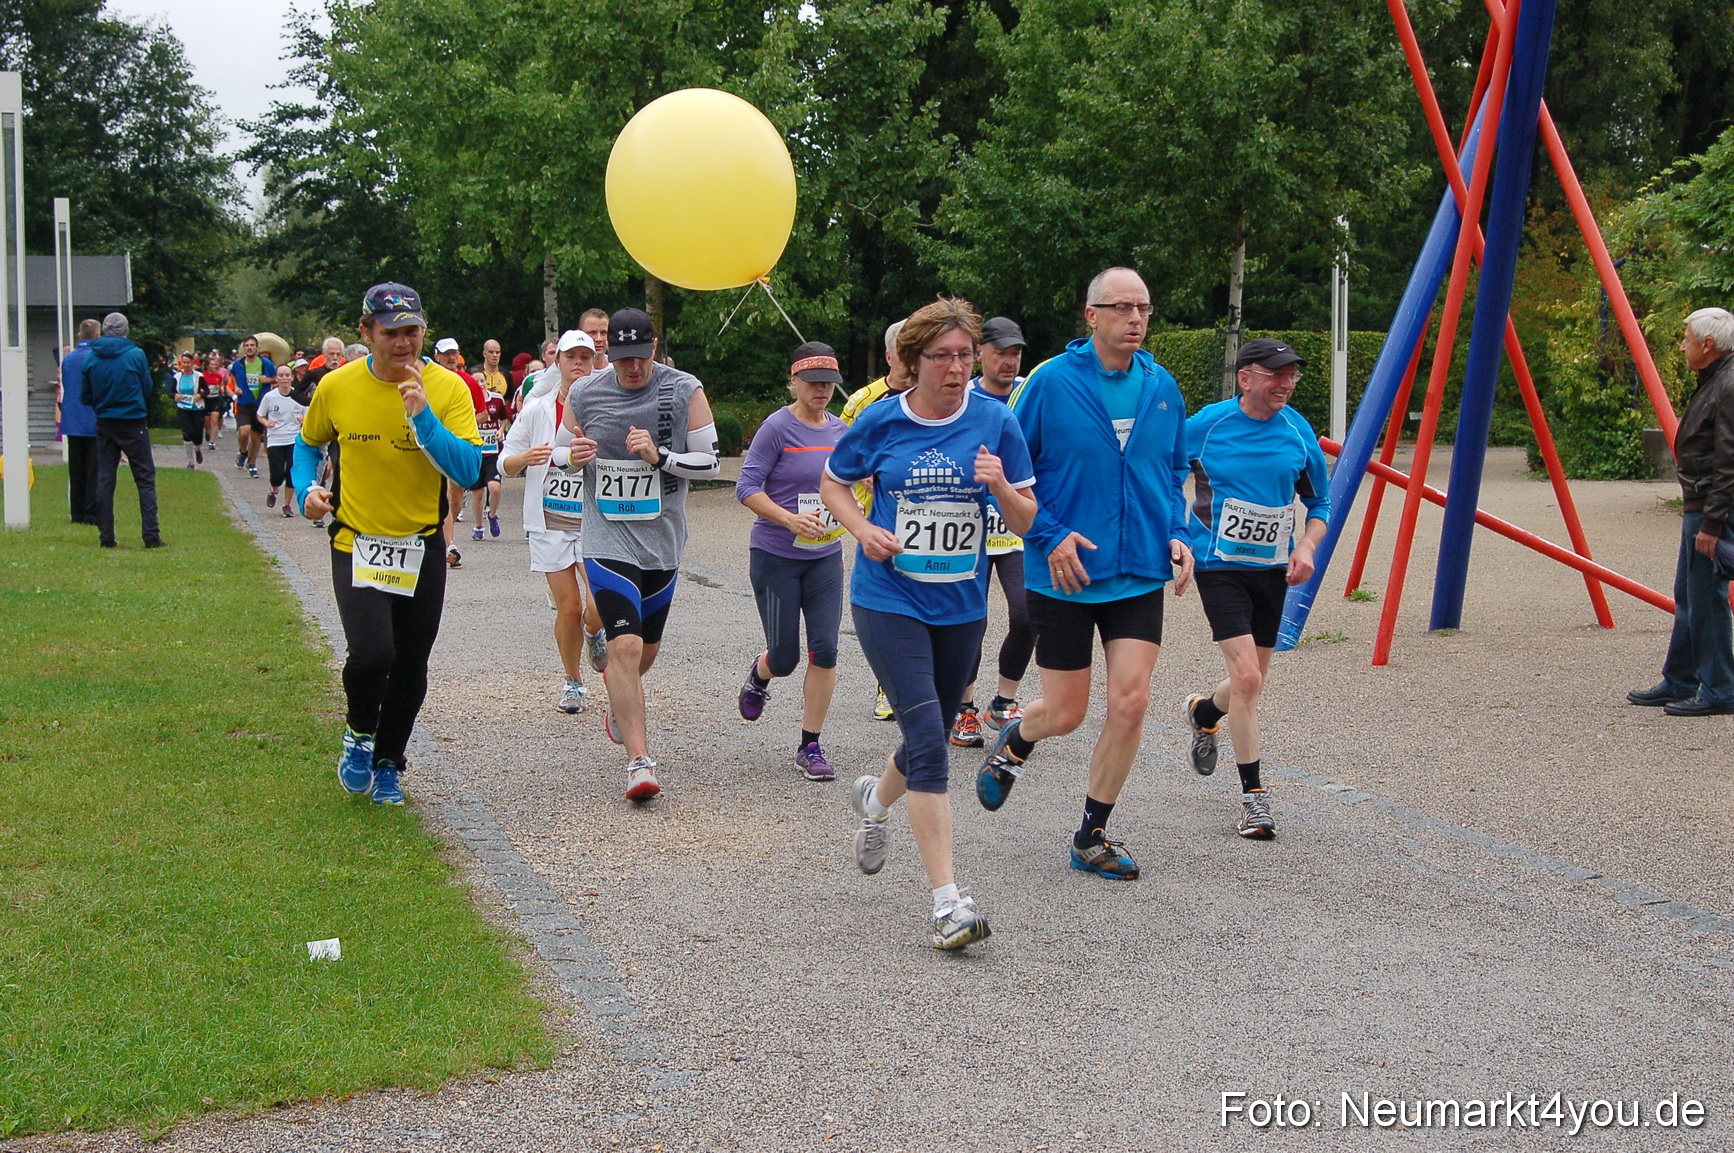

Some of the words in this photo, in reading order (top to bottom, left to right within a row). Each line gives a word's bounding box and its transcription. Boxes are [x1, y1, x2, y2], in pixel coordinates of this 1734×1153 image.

[347, 432, 381, 442] Jürgen
[597, 464, 616, 472] PARTL
[548, 479, 583, 499] 297
[601, 474, 654, 497] 2177
[903, 486, 948, 496] Neumarkter
[618, 503, 636, 512] Rob
[898, 507, 928, 517] PARTL
[929, 509, 971, 518] Neumarkt
[1224, 502, 1247, 515] PARTL
[1248, 509, 1279, 519] Neumarkt
[1223, 514, 1280, 543] 2558
[903, 520, 976, 551] 2102
[380, 539, 412, 547] Neumarkt
[368, 543, 408, 569] 231
[1235, 545, 1257, 555] Hans
[924, 559, 951, 571] Anni
[373, 571, 401, 585] Jürgen
